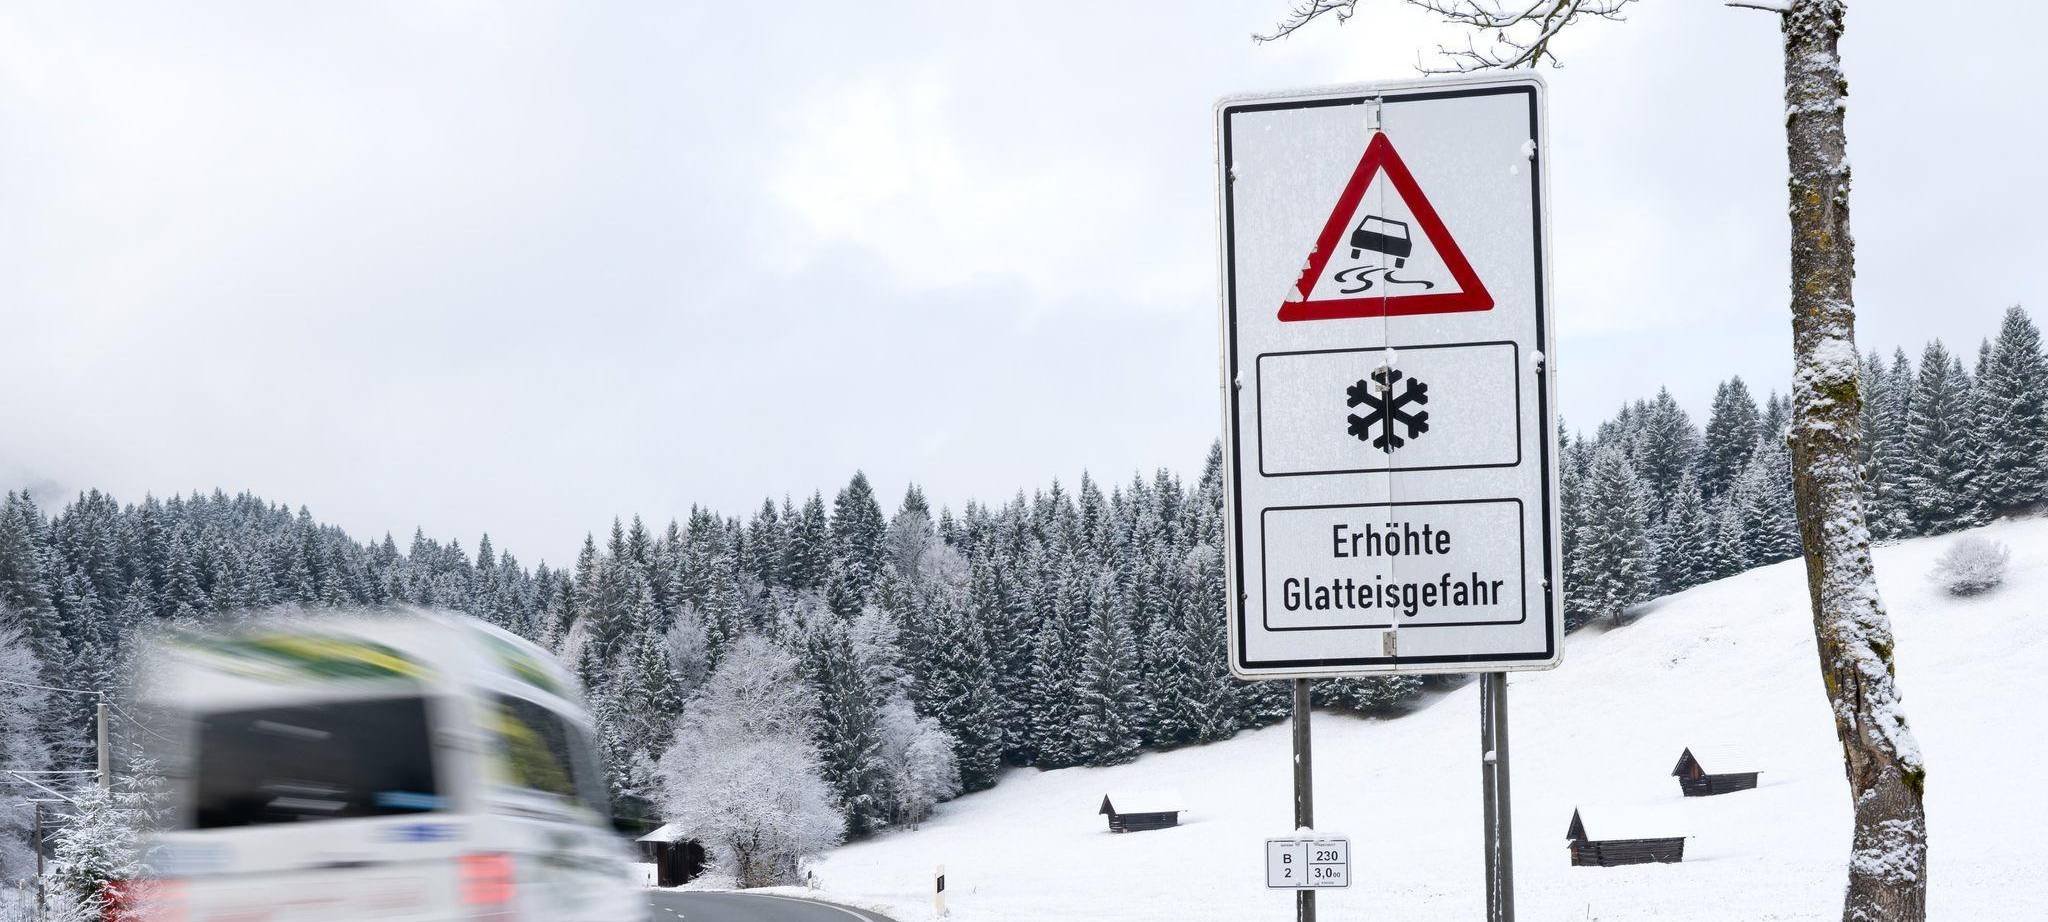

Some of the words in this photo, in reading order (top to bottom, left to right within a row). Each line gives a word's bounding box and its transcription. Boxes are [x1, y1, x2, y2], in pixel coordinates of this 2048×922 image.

[1333, 523, 1451, 558] Erhöhte
[1283, 571, 1504, 617] Glatteisgefahr
[1283, 853, 1292, 864] B
[1316, 851, 1338, 861] 230
[1284, 868, 1292, 878] 2
